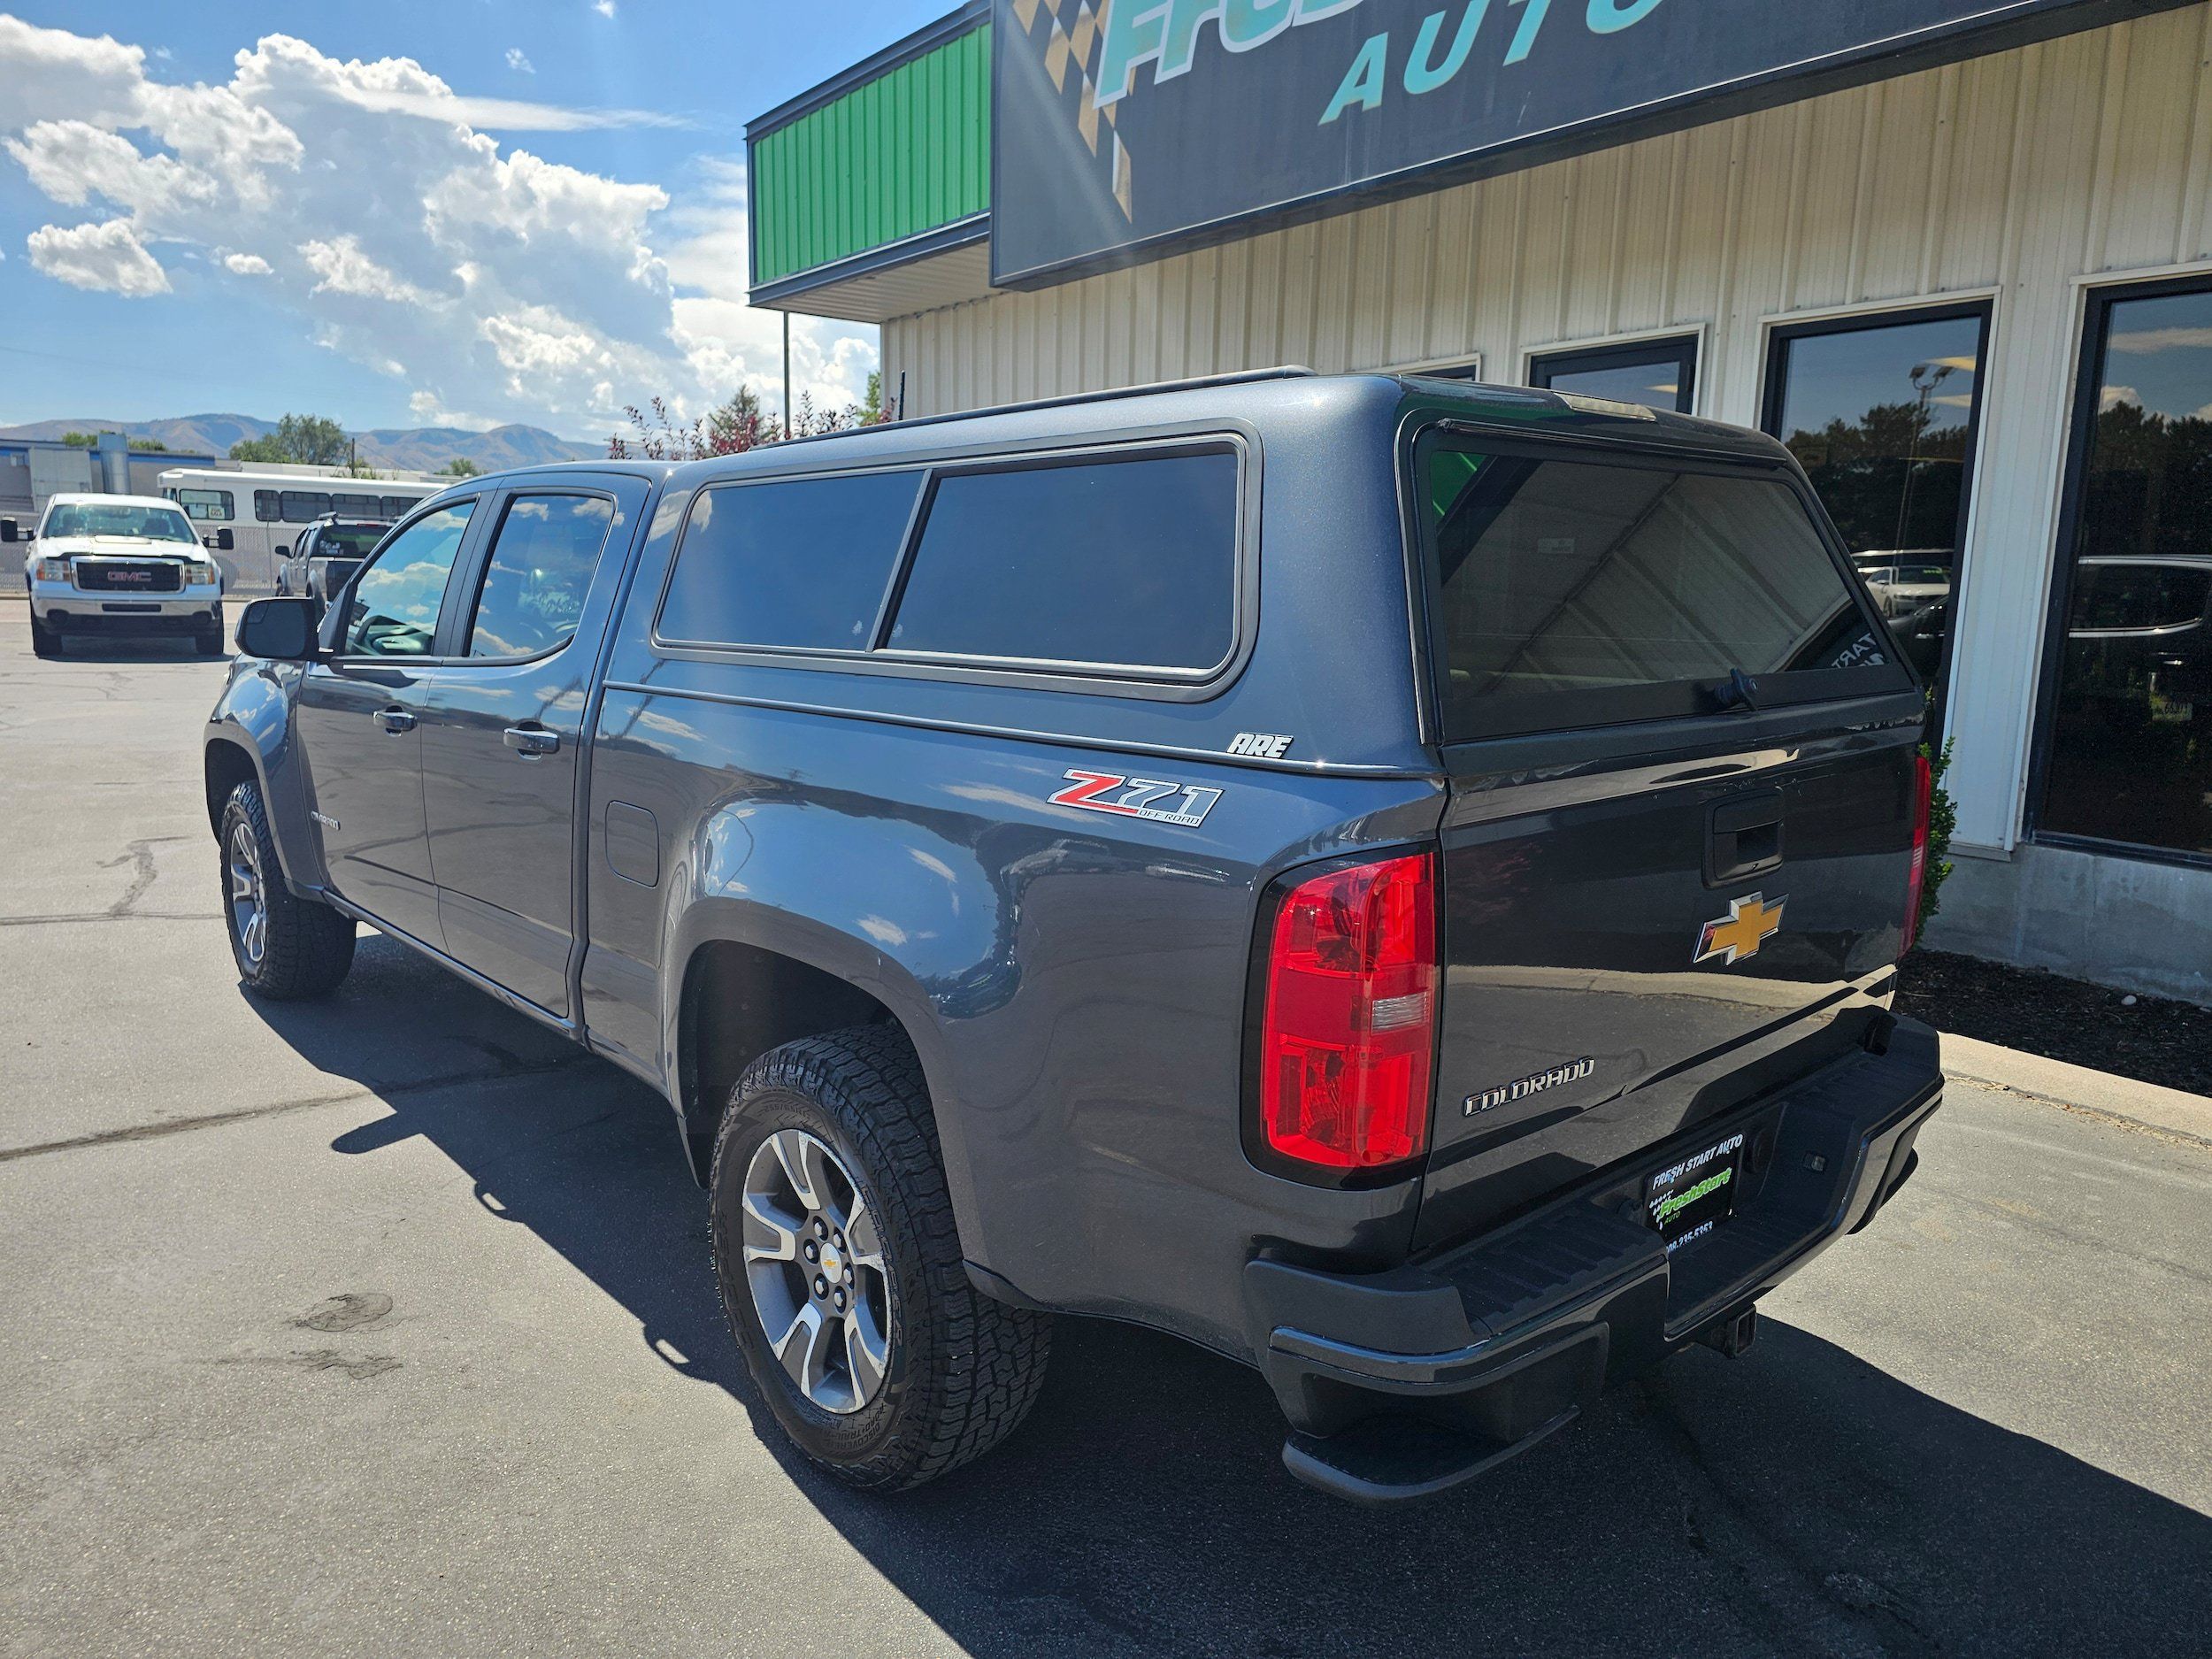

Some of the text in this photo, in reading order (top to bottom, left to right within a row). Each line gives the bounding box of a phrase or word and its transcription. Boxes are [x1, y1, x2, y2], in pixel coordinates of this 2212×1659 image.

[107, 571, 152, 582] GMC
[1226, 732, 1294, 758] ARE
[1047, 768, 1225, 825] Z71
[1139, 809, 1200, 825] OFF ROAD
[1463, 1056, 1596, 1117] COLORADO
[1652, 1133, 1744, 1191] FRESH START AUTO
